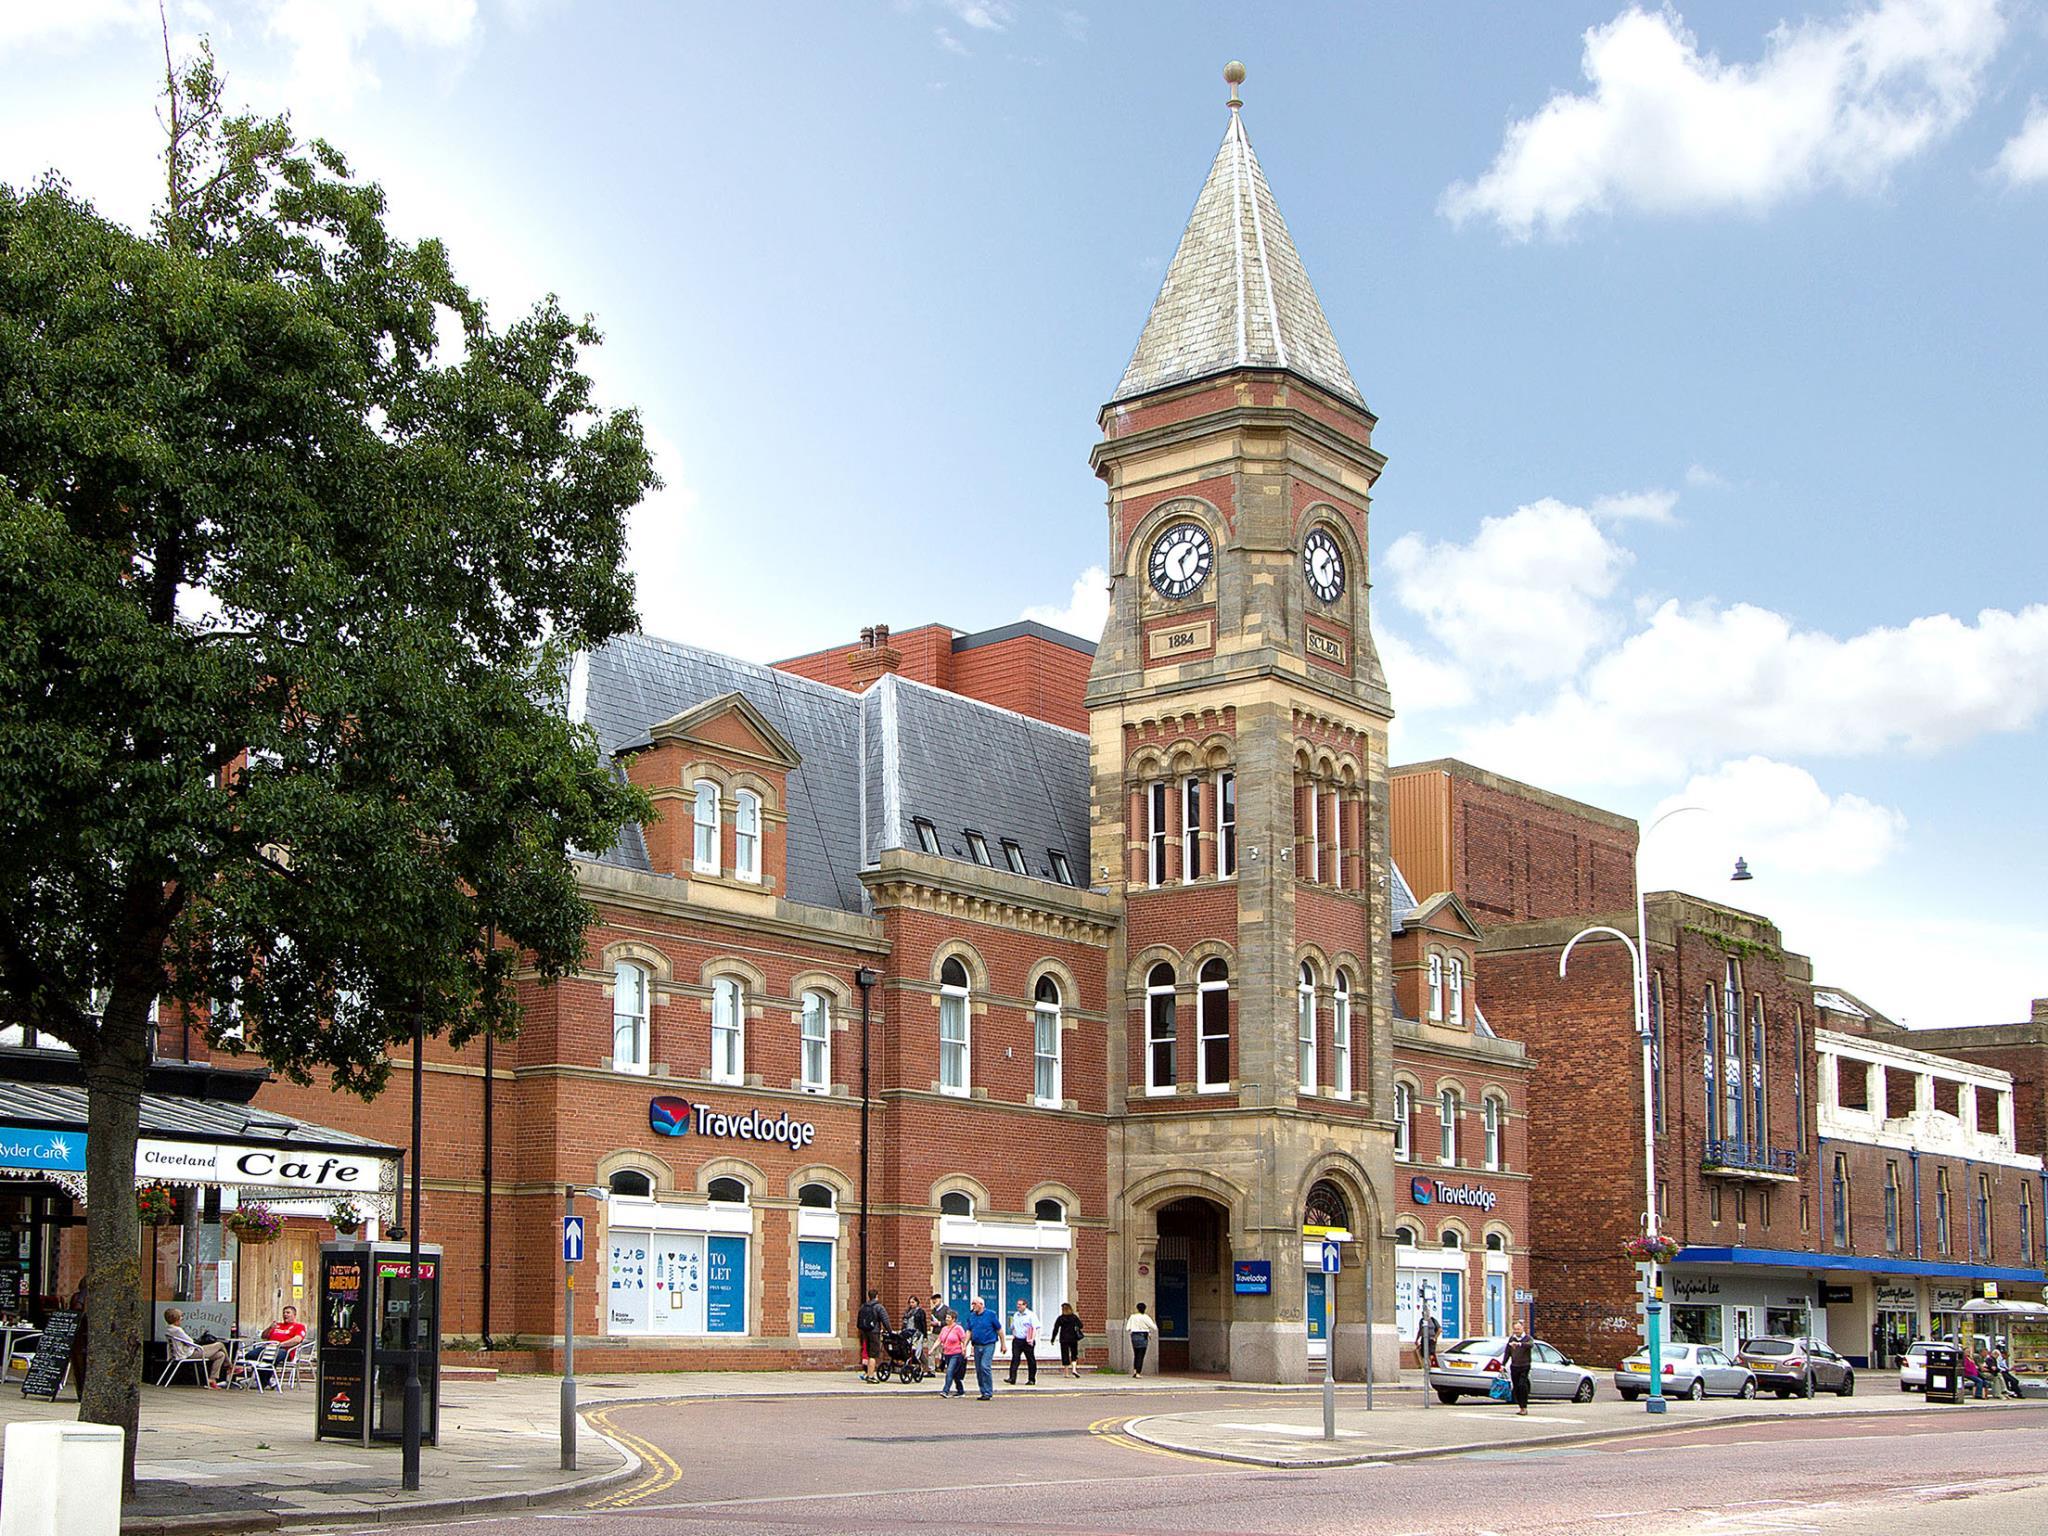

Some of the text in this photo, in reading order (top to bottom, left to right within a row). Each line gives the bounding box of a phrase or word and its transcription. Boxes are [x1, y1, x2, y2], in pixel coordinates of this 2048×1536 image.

[1168, 632, 1194, 648] 1884
[692, 1103, 815, 1150] Travelodge
[33, 1144, 61, 1159] Care
[144, 1151, 359, 1184] Cleveland Cafe
[1434, 1180, 1497, 1212] Travelodge
[710, 1252, 726, 1266] TO
[710, 1267, 732, 1281] LET
[980, 1265, 992, 1277] TO
[329, 1275, 360, 1290] MENU
[980, 1279, 997, 1290] LET
[1235, 1274, 1268, 1284] Travelodge
[1672, 1275, 1720, 1302] Virginia Lee
[387, 1300, 410, 1313] BT
